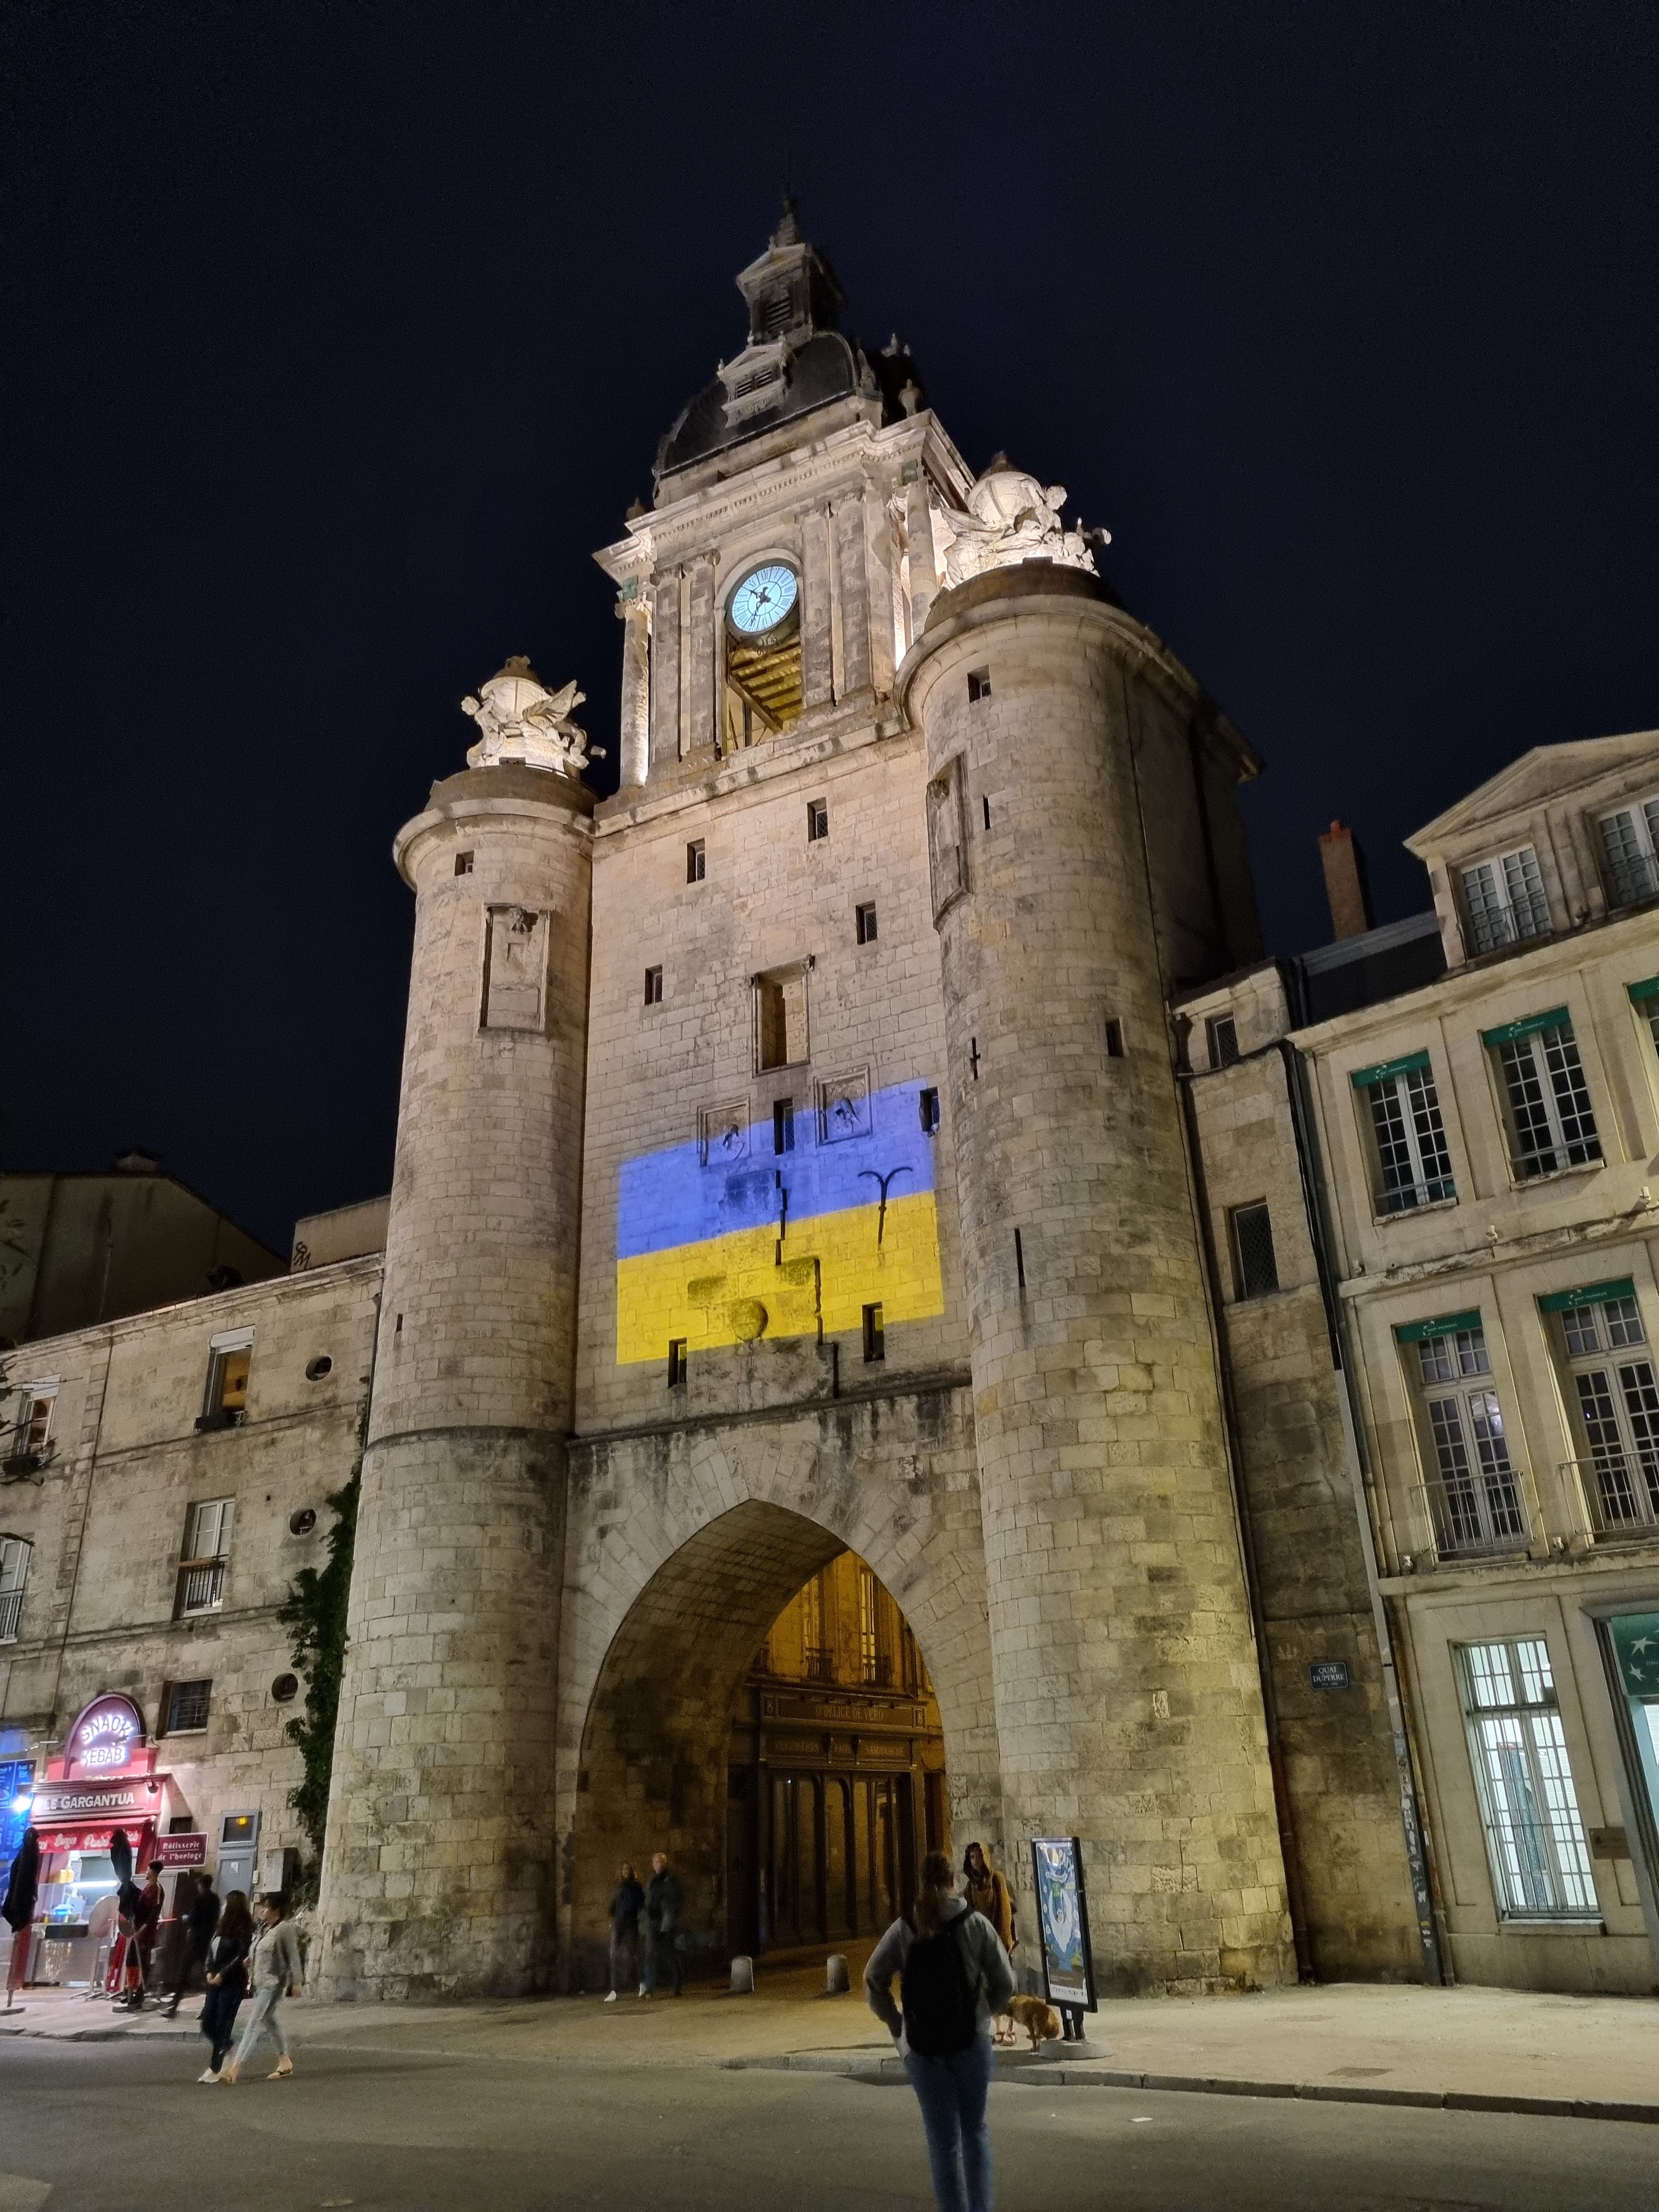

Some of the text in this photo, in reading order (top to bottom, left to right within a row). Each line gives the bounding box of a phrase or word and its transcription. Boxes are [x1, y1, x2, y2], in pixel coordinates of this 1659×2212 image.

[1318, 1666, 1336, 1675] QUAI
[81, 1716, 131, 1742] SNACK
[82, 1747, 122, 1766] KEBAB
[44, 1792, 135, 1811] LE GARGANTUA
